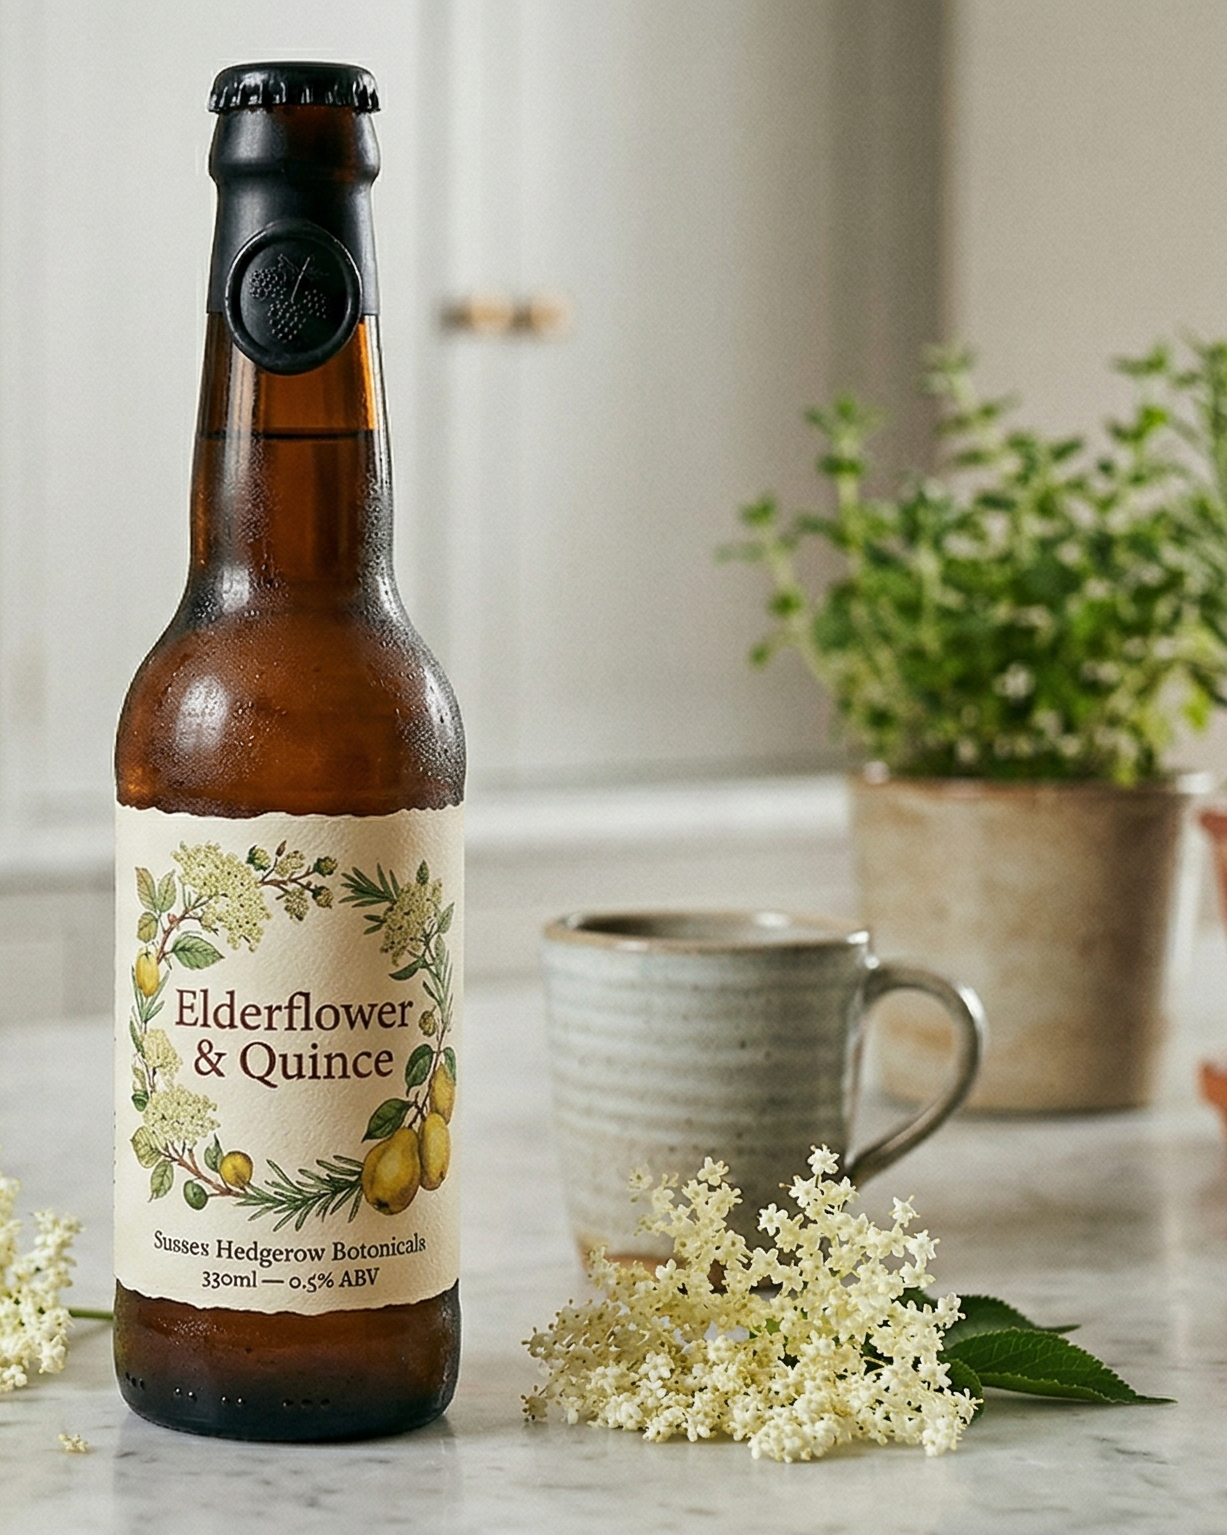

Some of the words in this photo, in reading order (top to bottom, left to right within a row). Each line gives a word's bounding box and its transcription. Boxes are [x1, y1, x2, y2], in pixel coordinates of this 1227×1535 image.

[175, 989, 414, 1032] Elderflower
[193, 1038, 227, 1078] &
[239, 1041, 394, 1089] Quince
[215, 1238, 326, 1269] Hedgerow
[201, 1270, 258, 1289] 330ml
[288, 1271, 335, 1293] 0.5%
[338, 1267, 381, 1288] ABV
